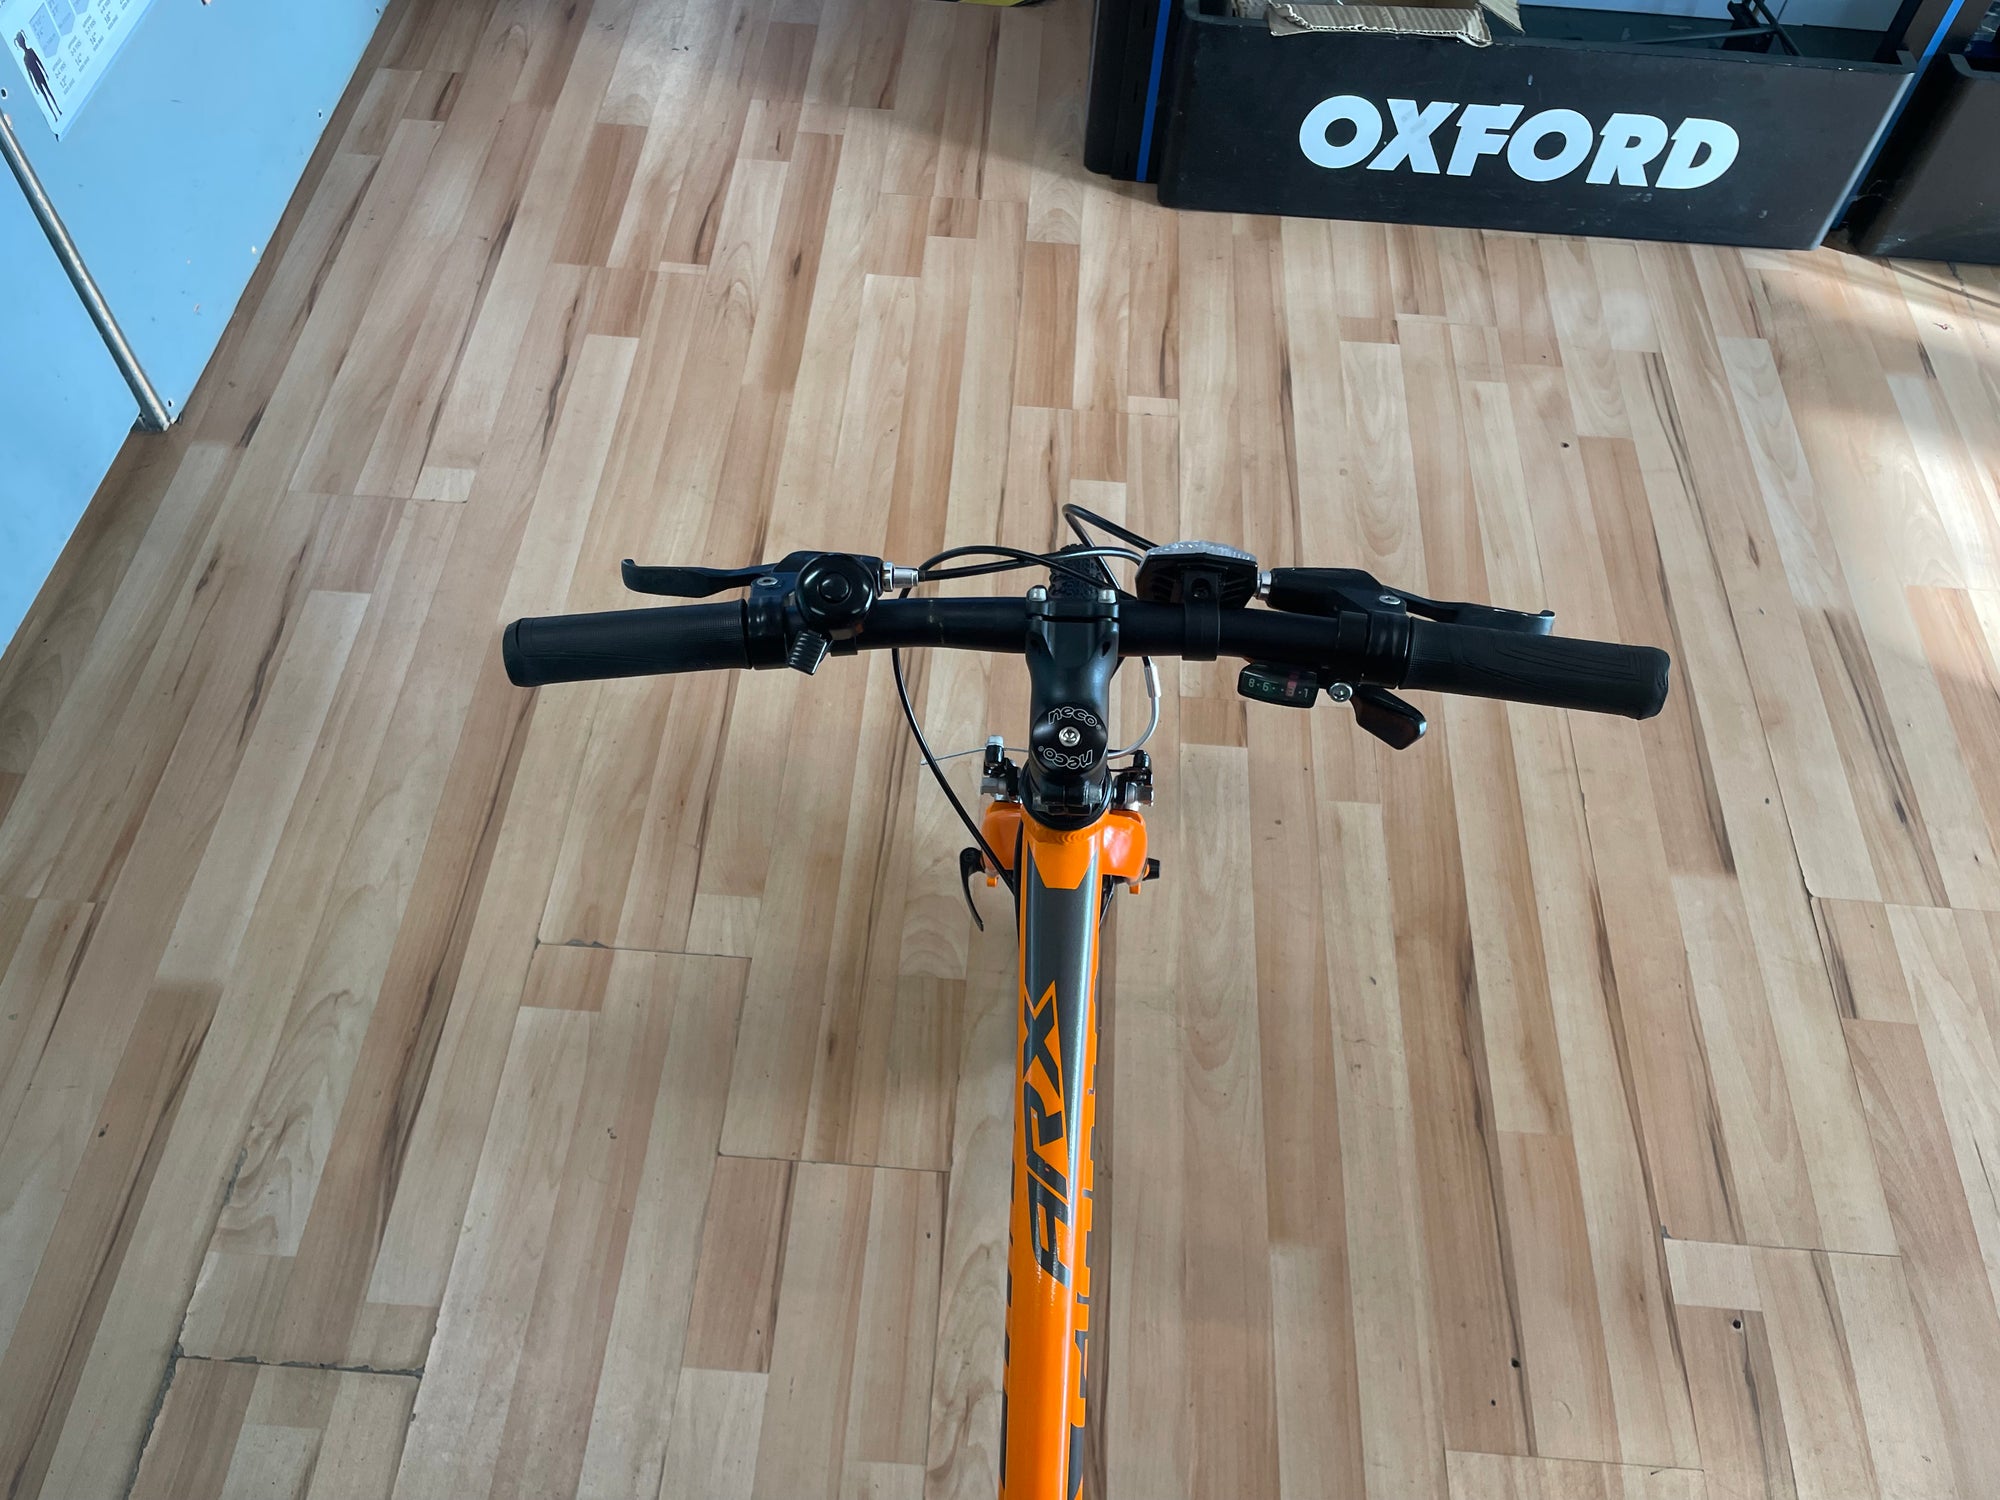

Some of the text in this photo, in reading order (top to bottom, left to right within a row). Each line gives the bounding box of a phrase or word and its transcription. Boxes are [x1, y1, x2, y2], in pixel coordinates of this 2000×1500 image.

[1298, 95, 1740, 190] OXFORD
[1048, 706, 1098, 727] neco
[1042, 747, 1094, 770] neco
[1023, 995, 1072, 1289] ARX
